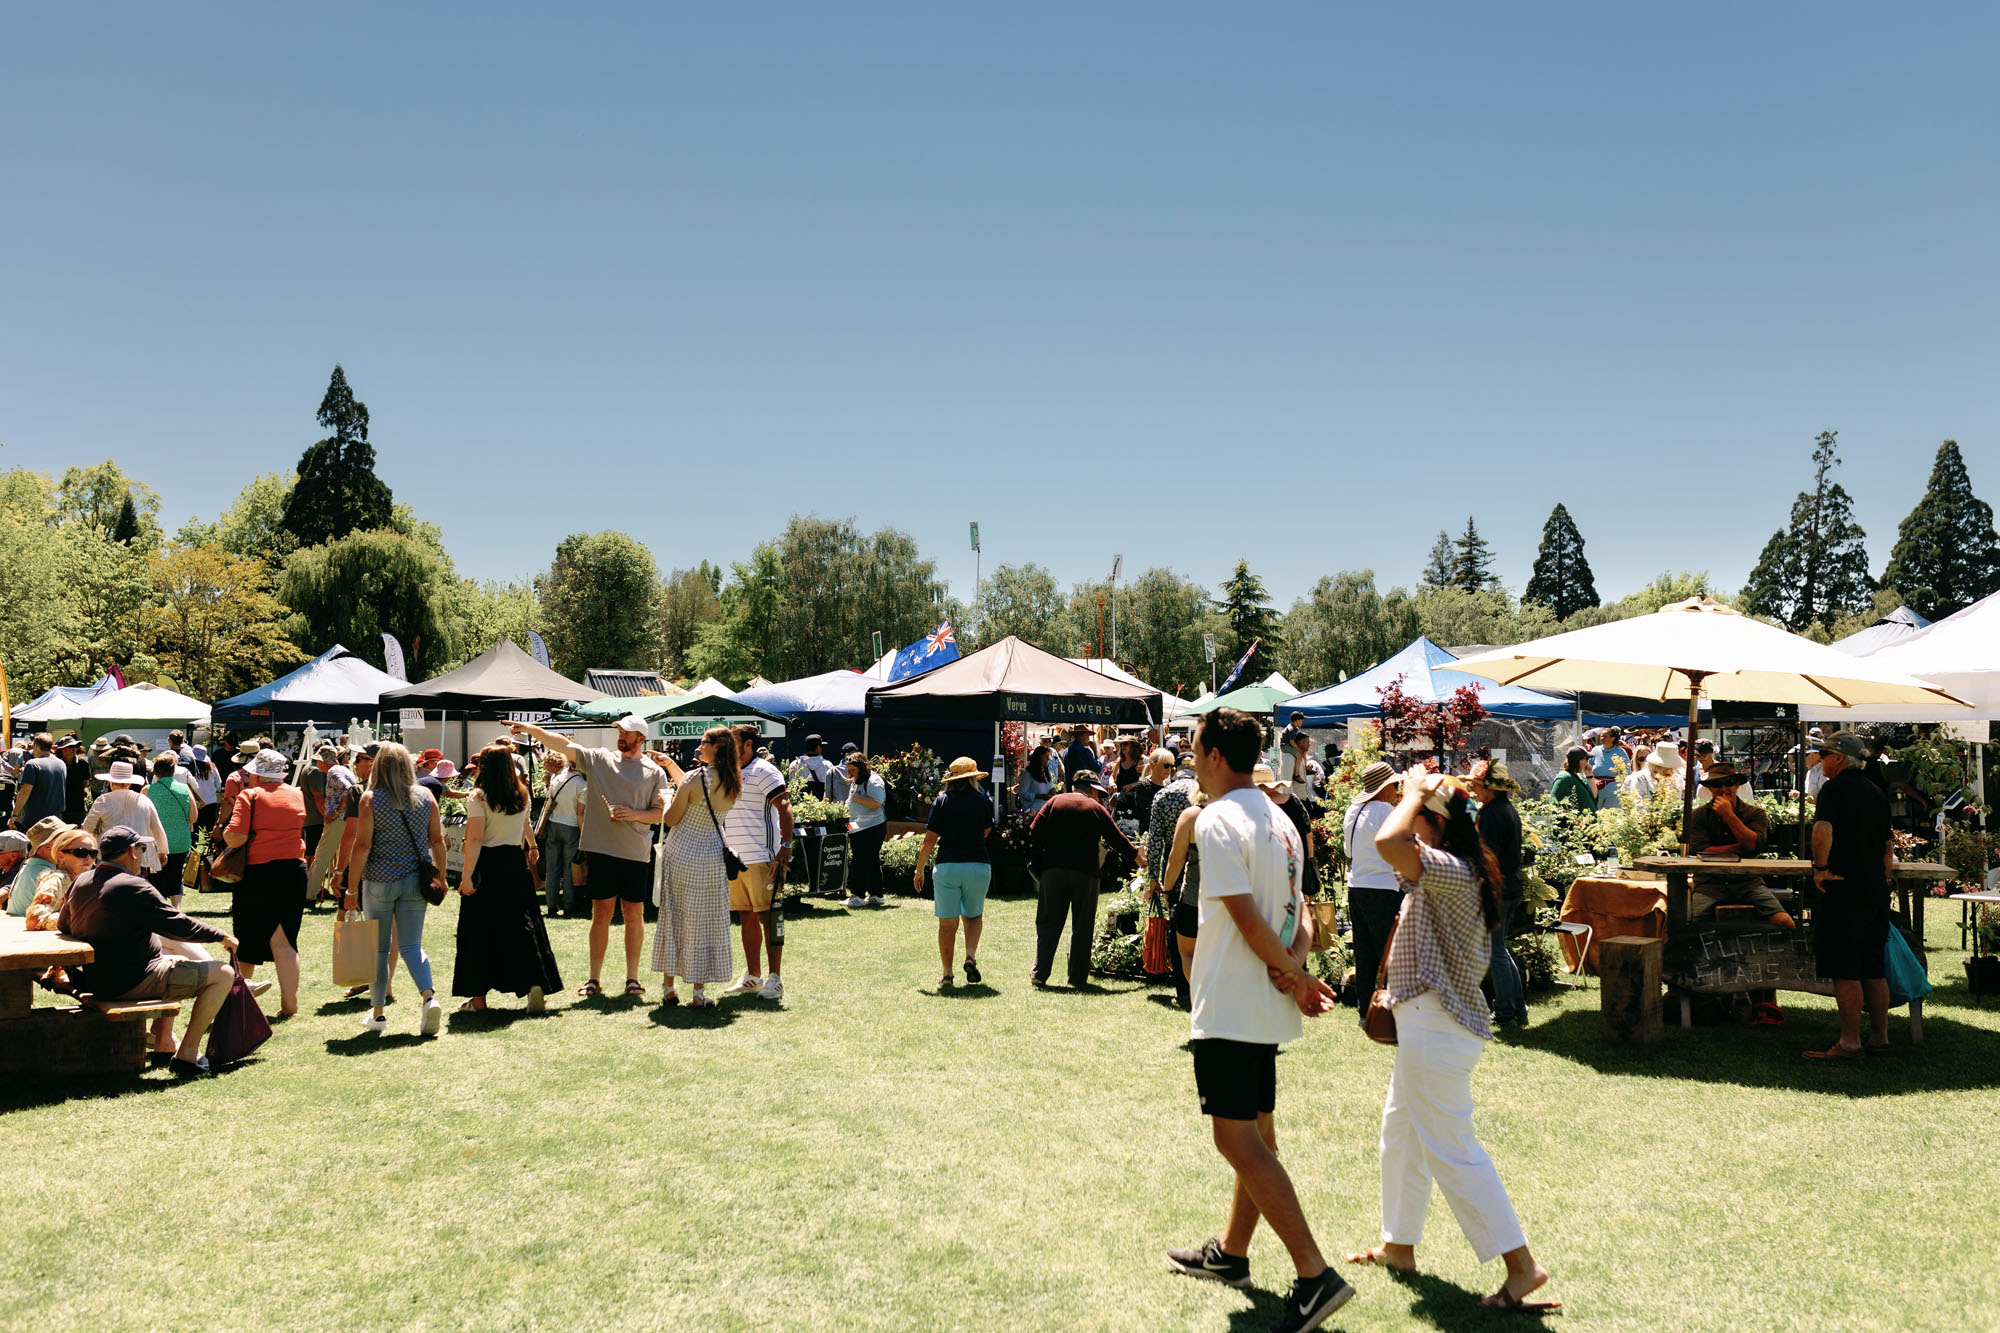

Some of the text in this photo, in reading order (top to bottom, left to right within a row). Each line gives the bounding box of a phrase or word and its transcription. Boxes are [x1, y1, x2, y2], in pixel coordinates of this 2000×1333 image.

[1006, 697, 1112, 716] Verve FLOWERS
[662, 721, 710, 736] Crafted
[1699, 930, 1809, 961] FLITCH
[1695, 963, 1781, 987] SLABS
